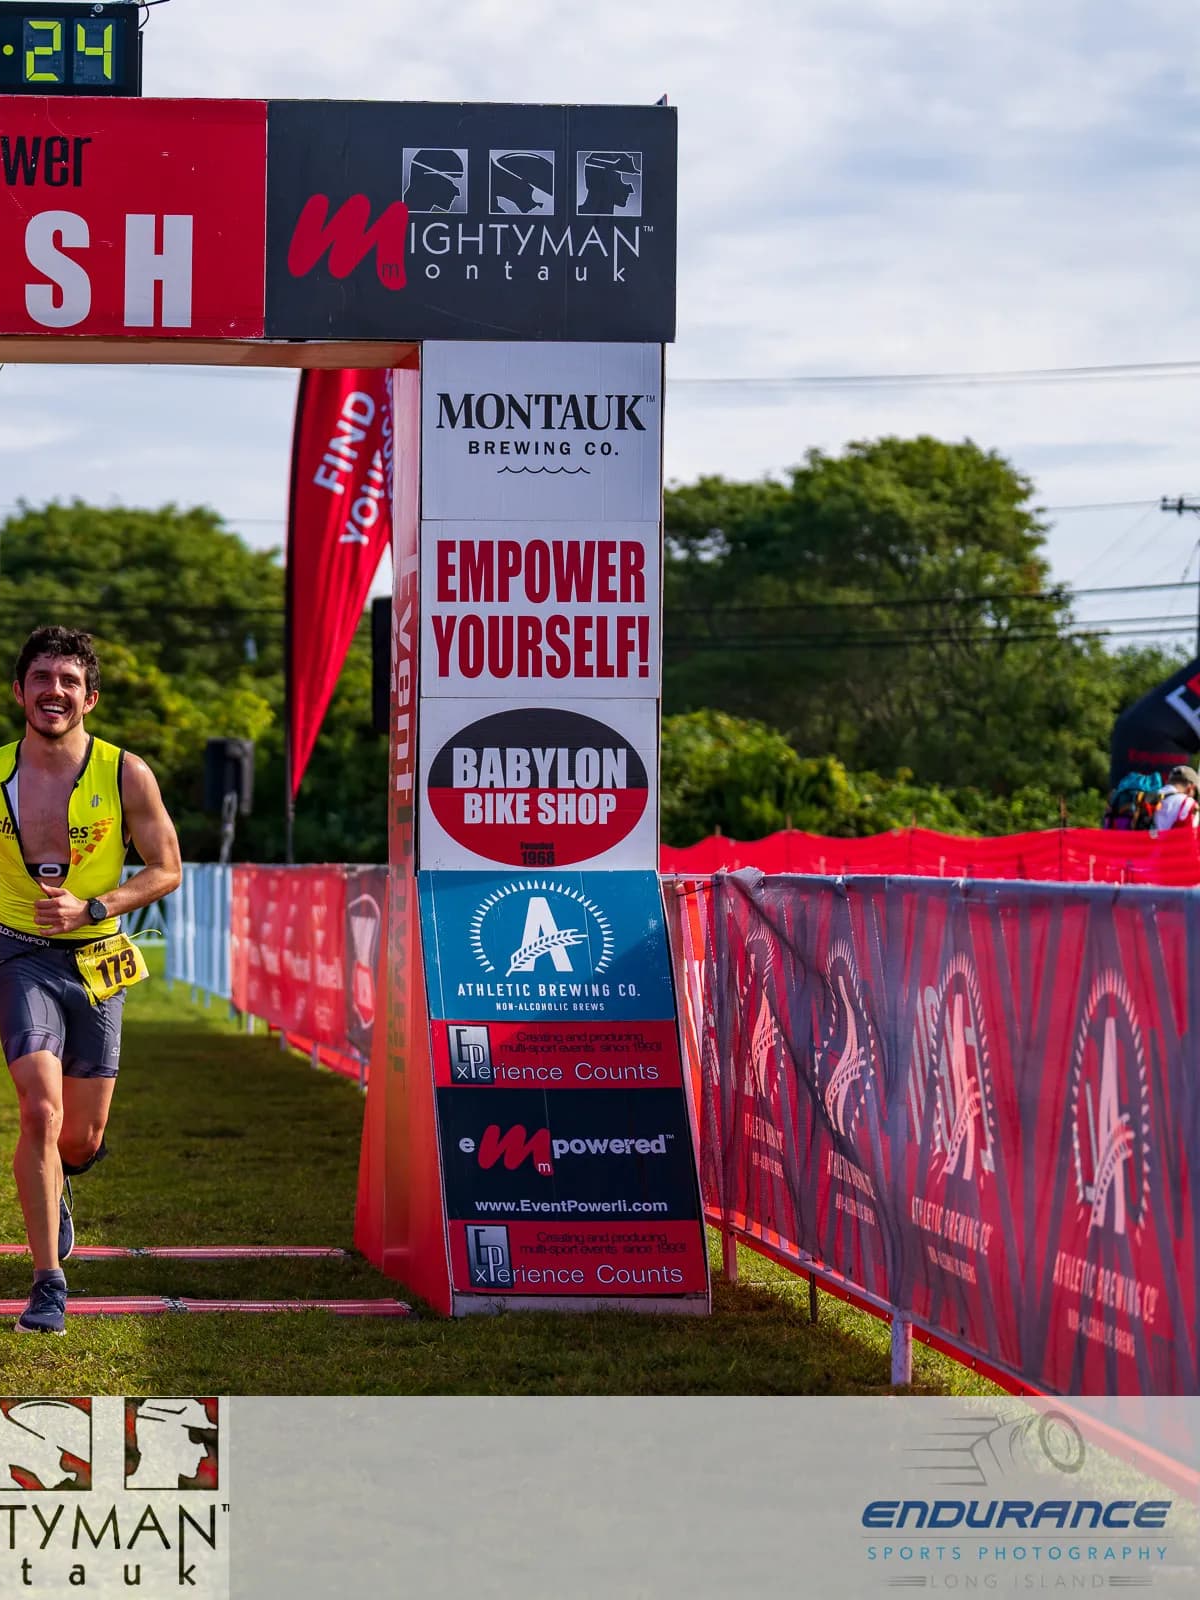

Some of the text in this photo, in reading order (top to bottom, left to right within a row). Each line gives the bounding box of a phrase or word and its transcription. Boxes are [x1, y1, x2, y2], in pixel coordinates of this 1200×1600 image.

[313, 391, 376, 495] FIND
[468, 441, 619, 456] BREWING CO.
[436, 539, 646, 604] EMPOWER
[432, 614, 650, 680] YOURSELF!
[452, 747, 627, 790] BABYLON
[463, 792, 617, 825] BIKE SHOP
[521, 850, 555, 866] 1968
[96, 949, 137, 988] 173
[457, 983, 641, 997] ATHLETIC BREWING CO.
[496, 1002, 605, 1011] NON-ALCOHOLIC BREWS
[574, 1061, 660, 1081] Counts
[596, 1264, 683, 1284] Counts
